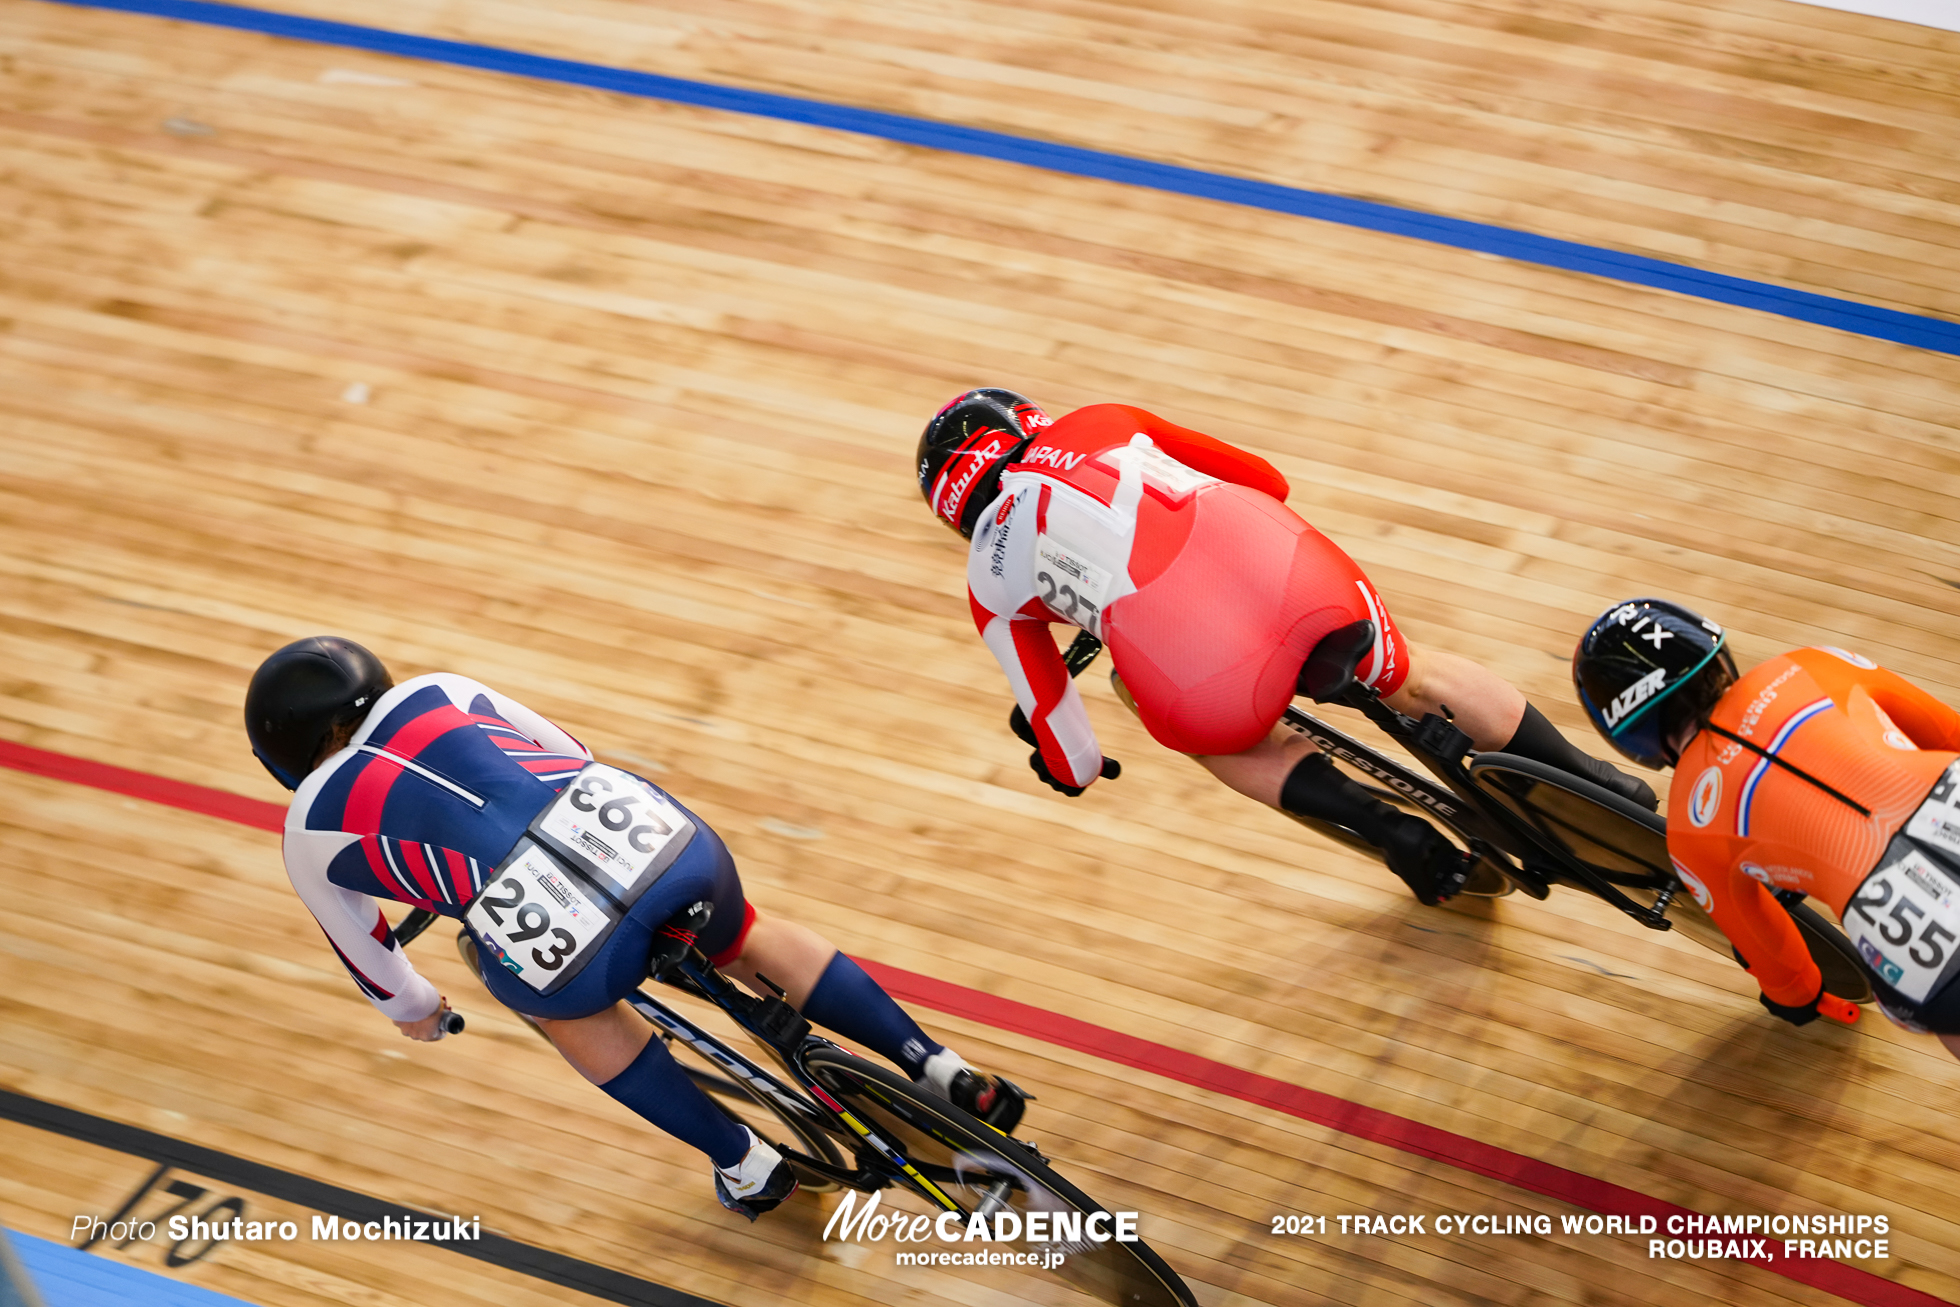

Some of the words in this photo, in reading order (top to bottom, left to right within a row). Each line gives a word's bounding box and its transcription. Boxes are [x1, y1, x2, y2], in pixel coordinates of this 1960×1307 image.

[942, 439, 1001, 522] Kabuto
[1037, 571, 1100, 637] 227
[1602, 668, 1667, 729] LAZER
[569, 775, 674, 854] 293
[570, 834, 598, 856] TISSOT
[526, 863, 541, 878] UCI
[556, 881, 582, 907] TISSOT
[479, 877, 578, 971] 293
[1850, 877, 1957, 970] 255
[634, 1002, 818, 1117] OOK
